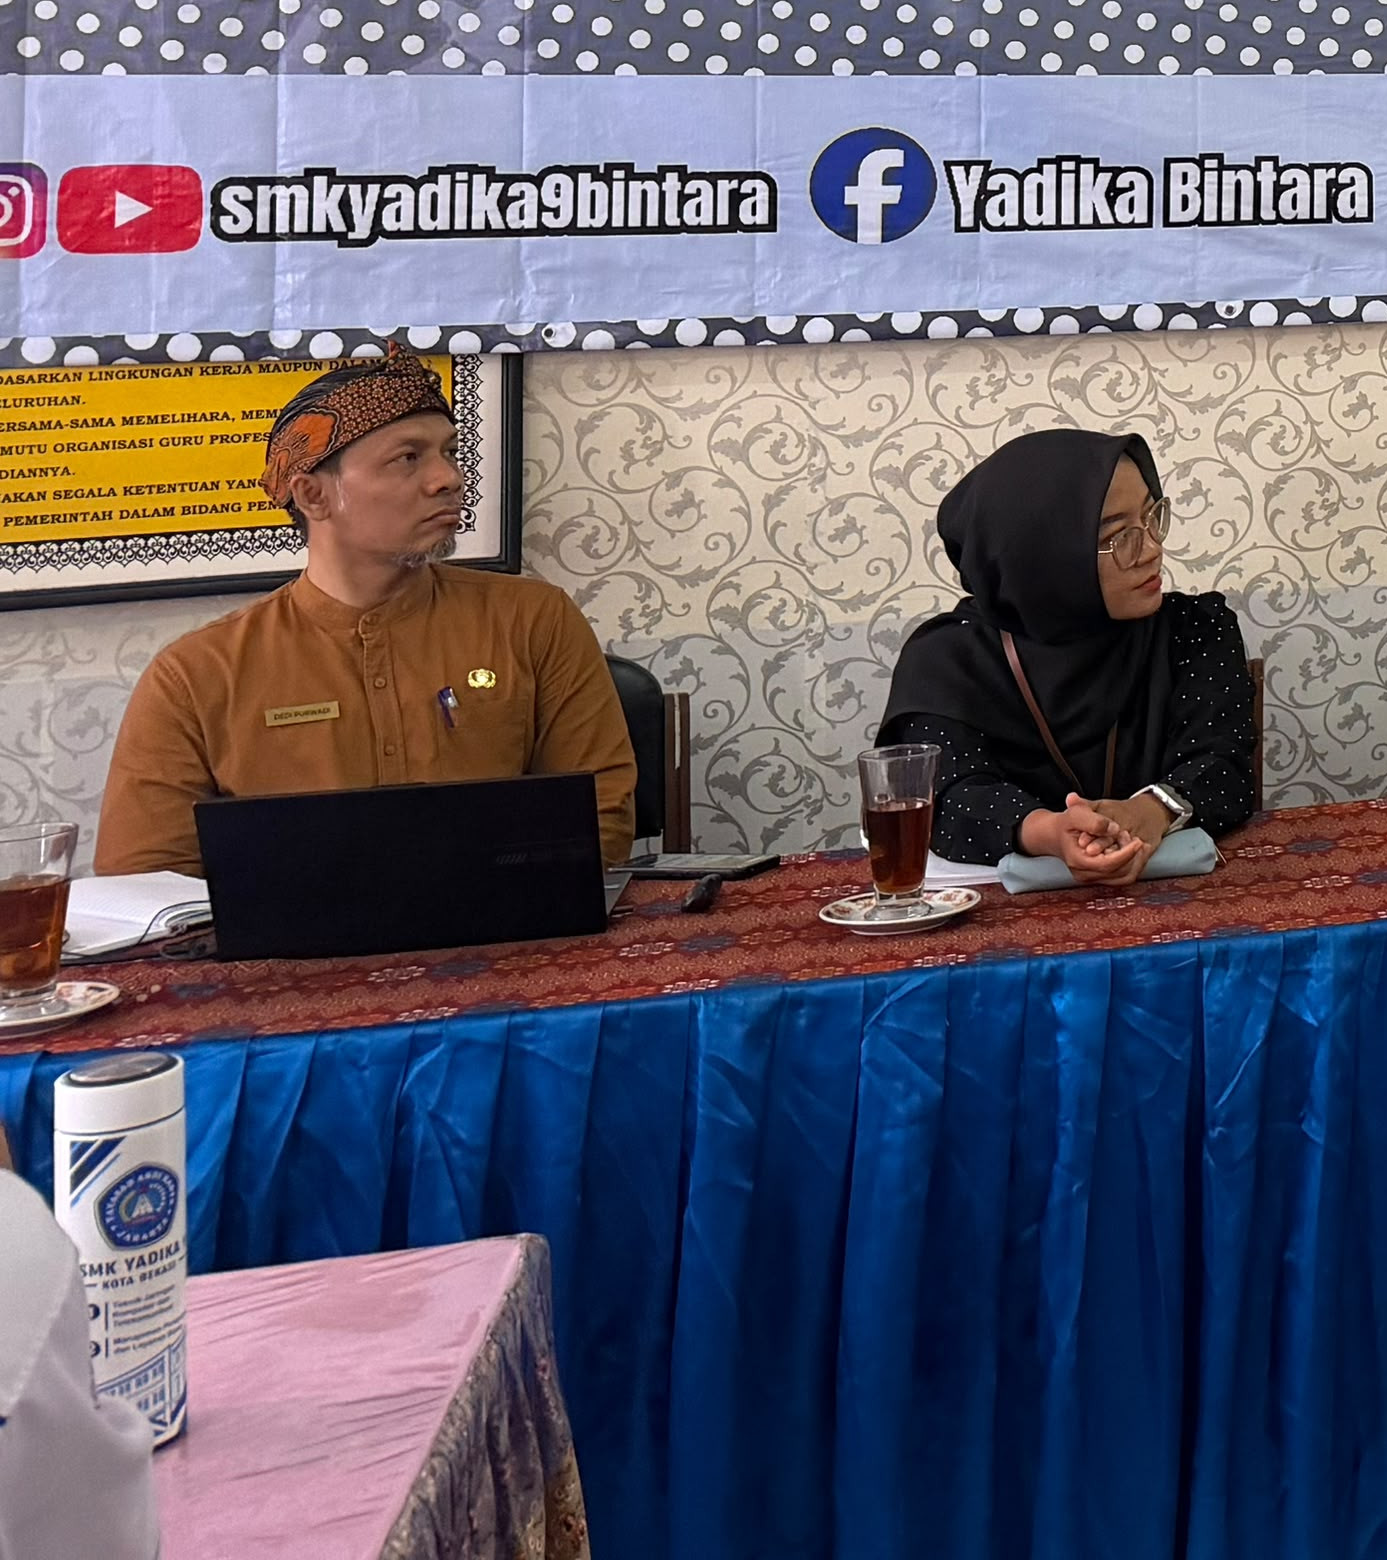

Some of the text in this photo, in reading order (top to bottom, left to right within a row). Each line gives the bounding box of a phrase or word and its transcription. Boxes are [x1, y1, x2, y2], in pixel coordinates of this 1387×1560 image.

[210, 162, 777, 248] smkyadika9bintara
[943, 155, 1153, 233] Yadika
[1163, 153, 1374, 229] Bintara
[88, 367, 194, 382] LINGKUNGAN
[200, 365, 252, 377] KERJA
[258, 361, 323, 374] MAUPUN
[122, 412, 235, 428] MEMELIHARA,
[0, 443, 48, 457] MUTU
[53, 438, 154, 453] ORGANISASI
[159, 435, 205, 448] GURU
[0, 490, 47, 504] AKAN
[52, 486, 118, 501] SEGALA
[123, 480, 220, 497] KETENTUAN
[3, 500, 281, 527] PEMERINTAH DALAM BIDANG PEN
[80, 1241, 180, 1278] SMK YADIKA
